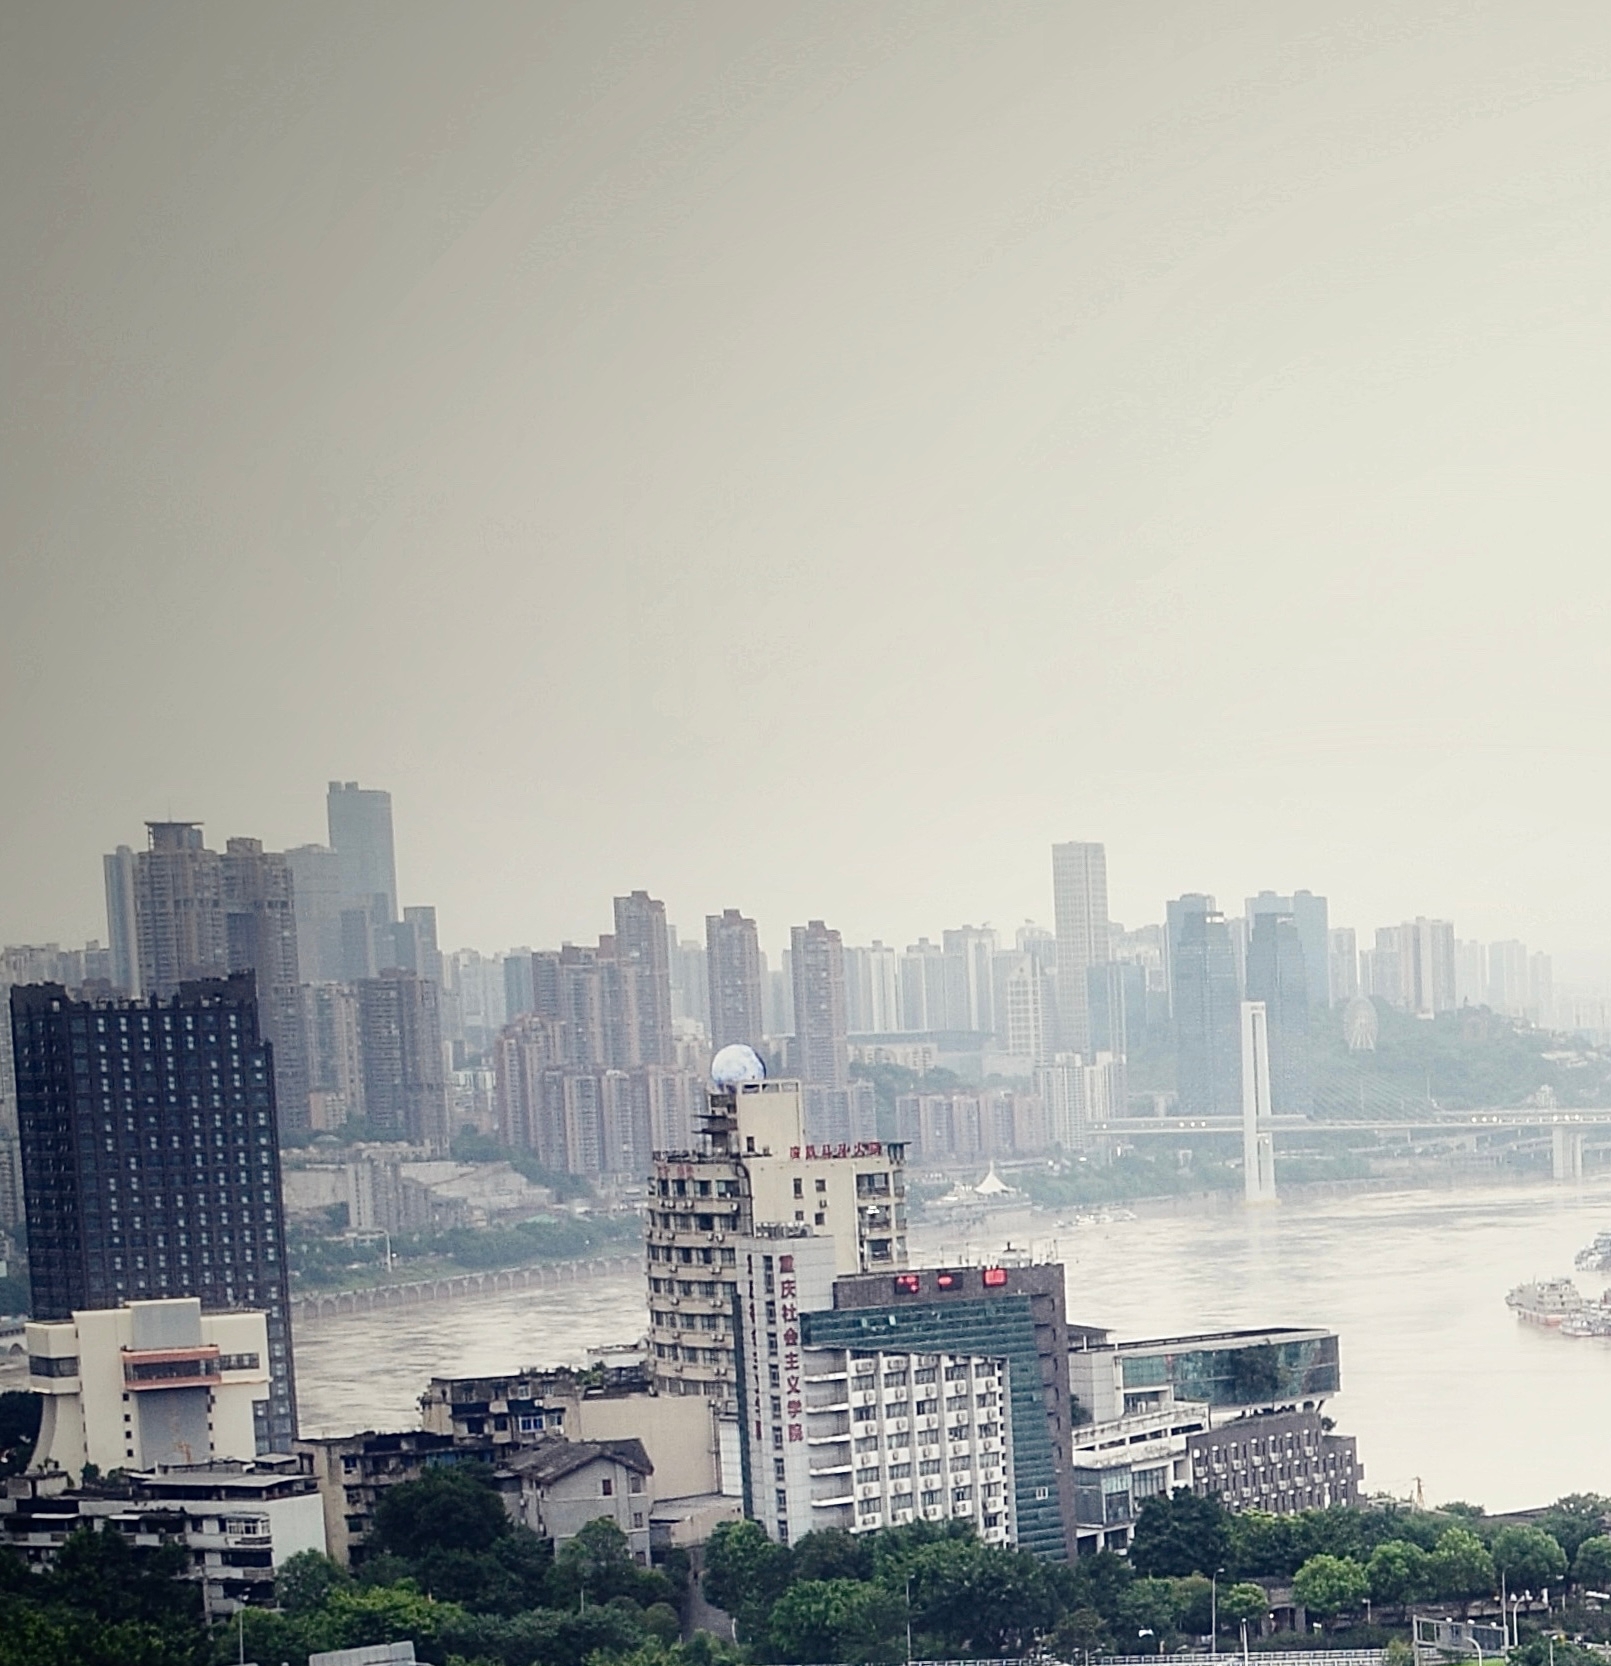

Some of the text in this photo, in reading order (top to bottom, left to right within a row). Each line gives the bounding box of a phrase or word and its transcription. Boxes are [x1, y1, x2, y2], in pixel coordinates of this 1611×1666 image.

[779, 1255, 803, 1442] 重庆社会主义学院
